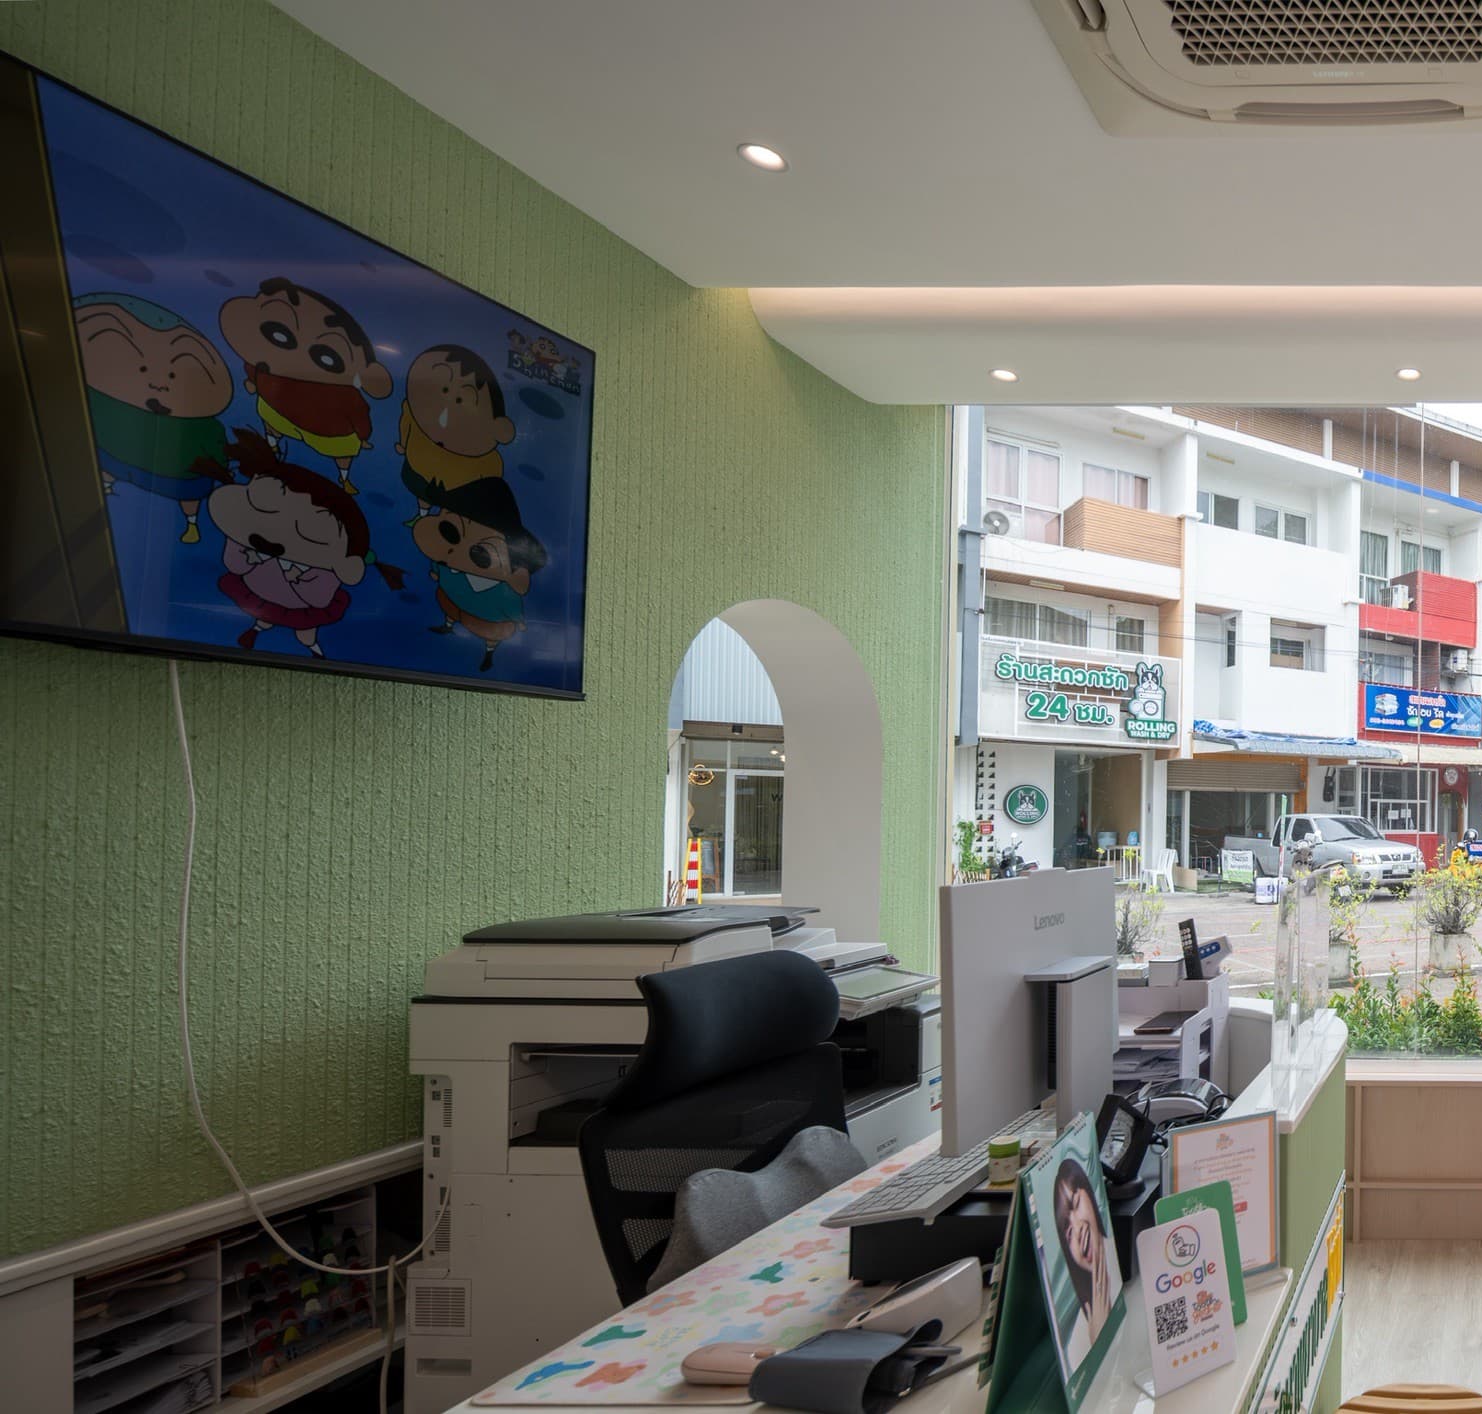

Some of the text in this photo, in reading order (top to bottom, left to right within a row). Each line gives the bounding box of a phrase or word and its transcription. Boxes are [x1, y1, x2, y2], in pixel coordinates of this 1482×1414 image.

[997, 653, 1128, 691] ร้านสะดวกซัก
[1027, 692, 1114, 724] 24 ชม.
[1127, 721, 1175, 733] ROLLING
[1034, 912, 1064, 930] Lenovo
[1156, 1259, 1216, 1293] Google
